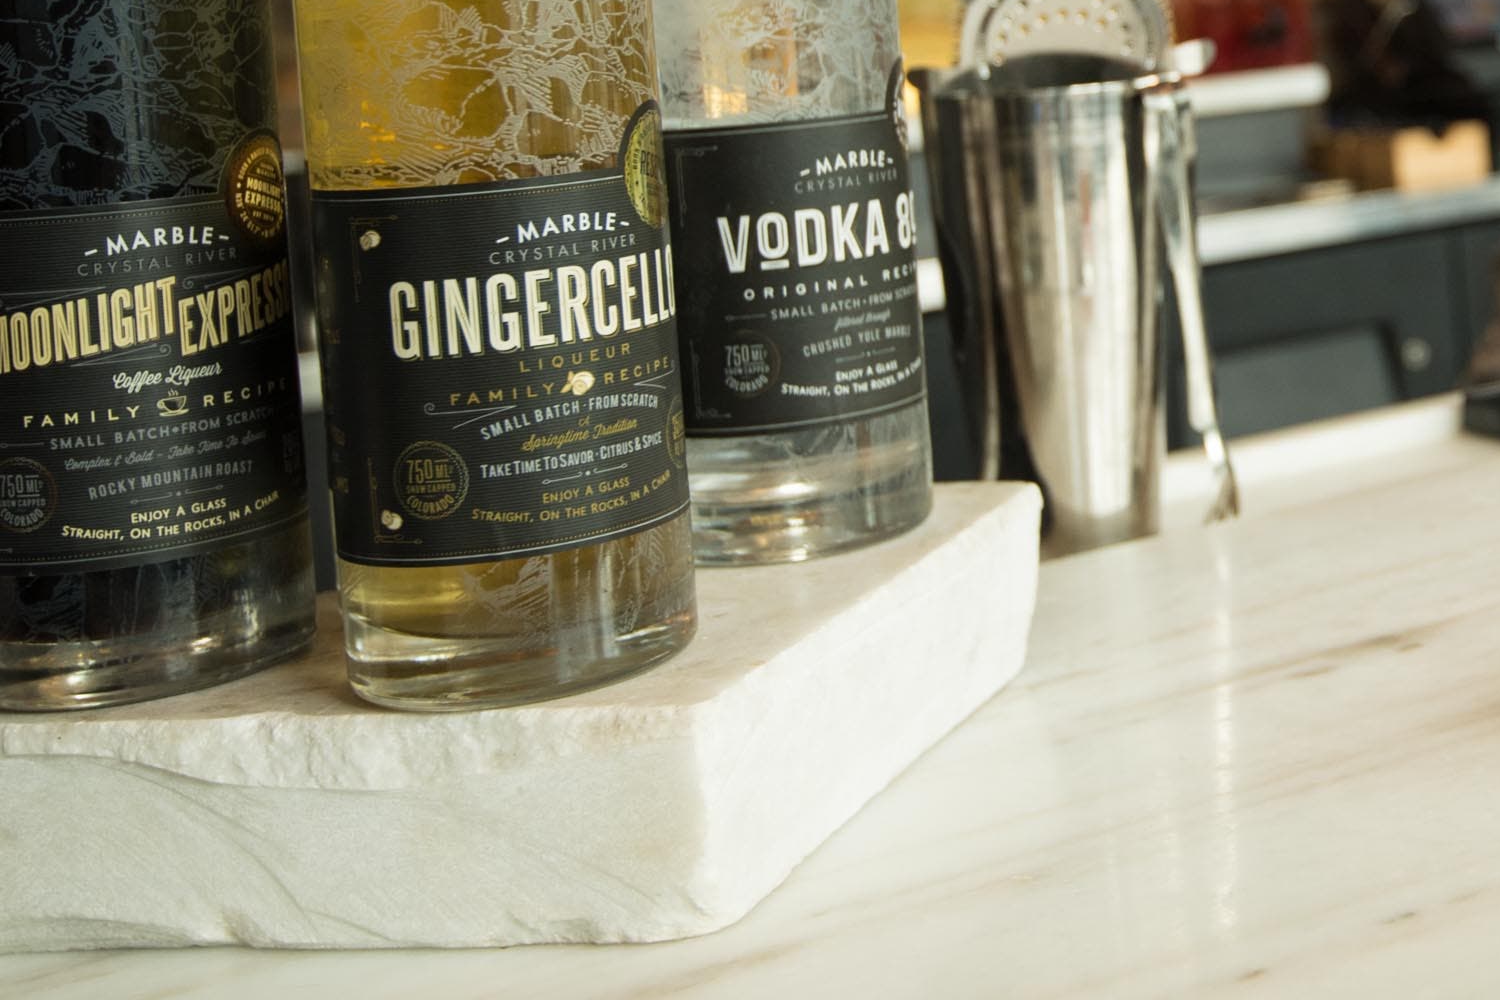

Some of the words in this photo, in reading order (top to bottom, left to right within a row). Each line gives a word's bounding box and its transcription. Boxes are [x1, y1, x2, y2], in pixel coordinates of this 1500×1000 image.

[815, 149, 886, 176] MARBLE
[794, 175, 862, 195] CRYSTAL
[106, 226, 214, 257] MARBLE
[517, 211, 617, 244] MARBLE
[716, 198, 891, 275] VODKA
[77, 256, 173, 277] CRYSTAL
[185, 247, 238, 265] RIVER
[488, 243, 581, 266] CRYSTAL
[590, 233, 637, 253] RIVER
[388, 243, 676, 361] GINGERCELLO
[743, 274, 869, 301] ORIGINAL
[770, 308, 815, 321] SMALL
[821, 298, 861, 315] BATCH
[520, 342, 632, 373] LIQUEUR
[802, 334, 852, 358] CRUSHED
[113, 371, 163, 394] Coffee
[165, 361, 223, 387] Liqueur
[450, 382, 555, 407] FAMILY
[604, 355, 670, 385] RECIPE
[780, 382, 831, 397] STRAIGHT,
[833, 384, 850, 396] ON
[853, 381, 869, 395] THE
[835, 368, 864, 382] ENJOY
[865, 365, 874, 377] A
[23, 405, 141, 428] FAMILY
[203, 377, 287, 408] RECIPE
[479, 412, 532, 441] SMALL
[534, 400, 580, 423] BATCH
[588, 395, 620, 411] FROM
[620, 393, 659, 409] SCRATCH
[50, 433, 105, 451] SMALL
[114, 425, 170, 444] BATCH
[181, 417, 221, 435] FROM
[520, 428, 591, 451] Springtime
[592, 418, 639, 440] Tradition
[599, 441, 634, 460] CITRUS
[88, 471, 136, 501] ROCKY
[141, 463, 213, 489] MOUNTAIN
[215, 459, 253, 477] ROAST
[406, 458, 433, 484] 750
[406, 494, 455, 514] COLORADO
[471, 507, 535, 523] STRAIGHT,
[539, 509, 560, 522] ON
[564, 506, 587, 519] THE
[591, 495, 629, 514] ROCKS,
[630, 489, 641, 501] IN
[642, 485, 650, 497] A
[541, 488, 580, 505] ENJOY
[584, 484, 594, 496] A
[598, 476, 631, 493] GLASS
[61, 525, 125, 541] STRAIGHT,
[129, 527, 151, 540] ON
[156, 524, 180, 537] THE
[184, 516, 226, 534] ROCKS,
[228, 509, 241, 522] IN
[243, 504, 253, 517] A
[254, 490, 280, 511] CHAIR
[130, 508, 170, 524] ENJOY
[175, 504, 187, 516] A
[190, 498, 228, 514] GLASS
